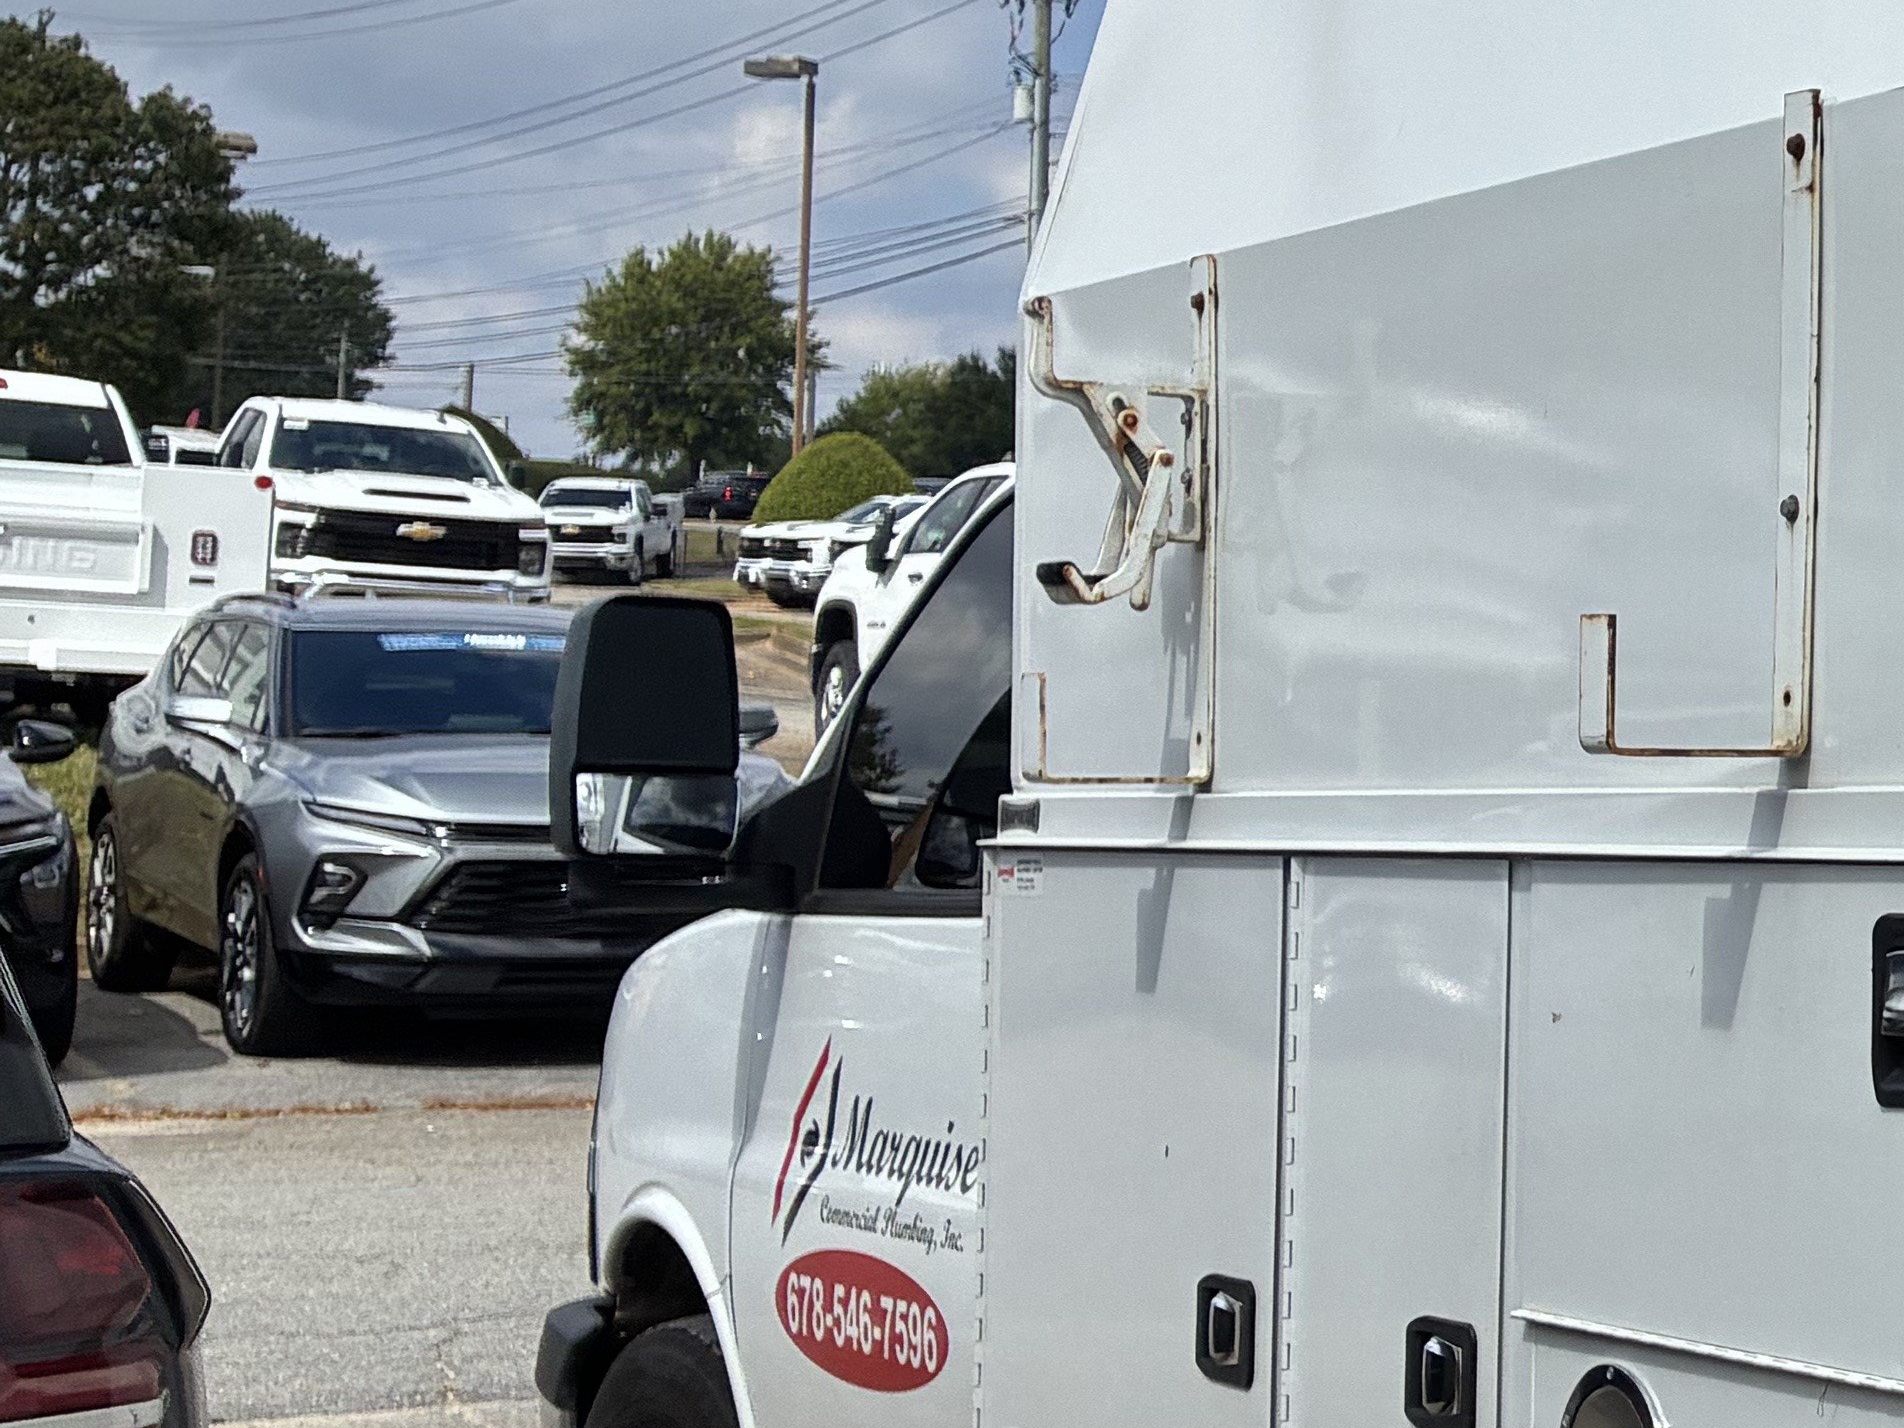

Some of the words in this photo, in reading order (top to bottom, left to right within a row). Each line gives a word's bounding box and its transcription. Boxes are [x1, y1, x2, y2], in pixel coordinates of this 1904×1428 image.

[831, 1094, 980, 1207] Marquise
[940, 1218, 965, 1253] Inc.
[786, 1271, 939, 1375] 678-546-7596
